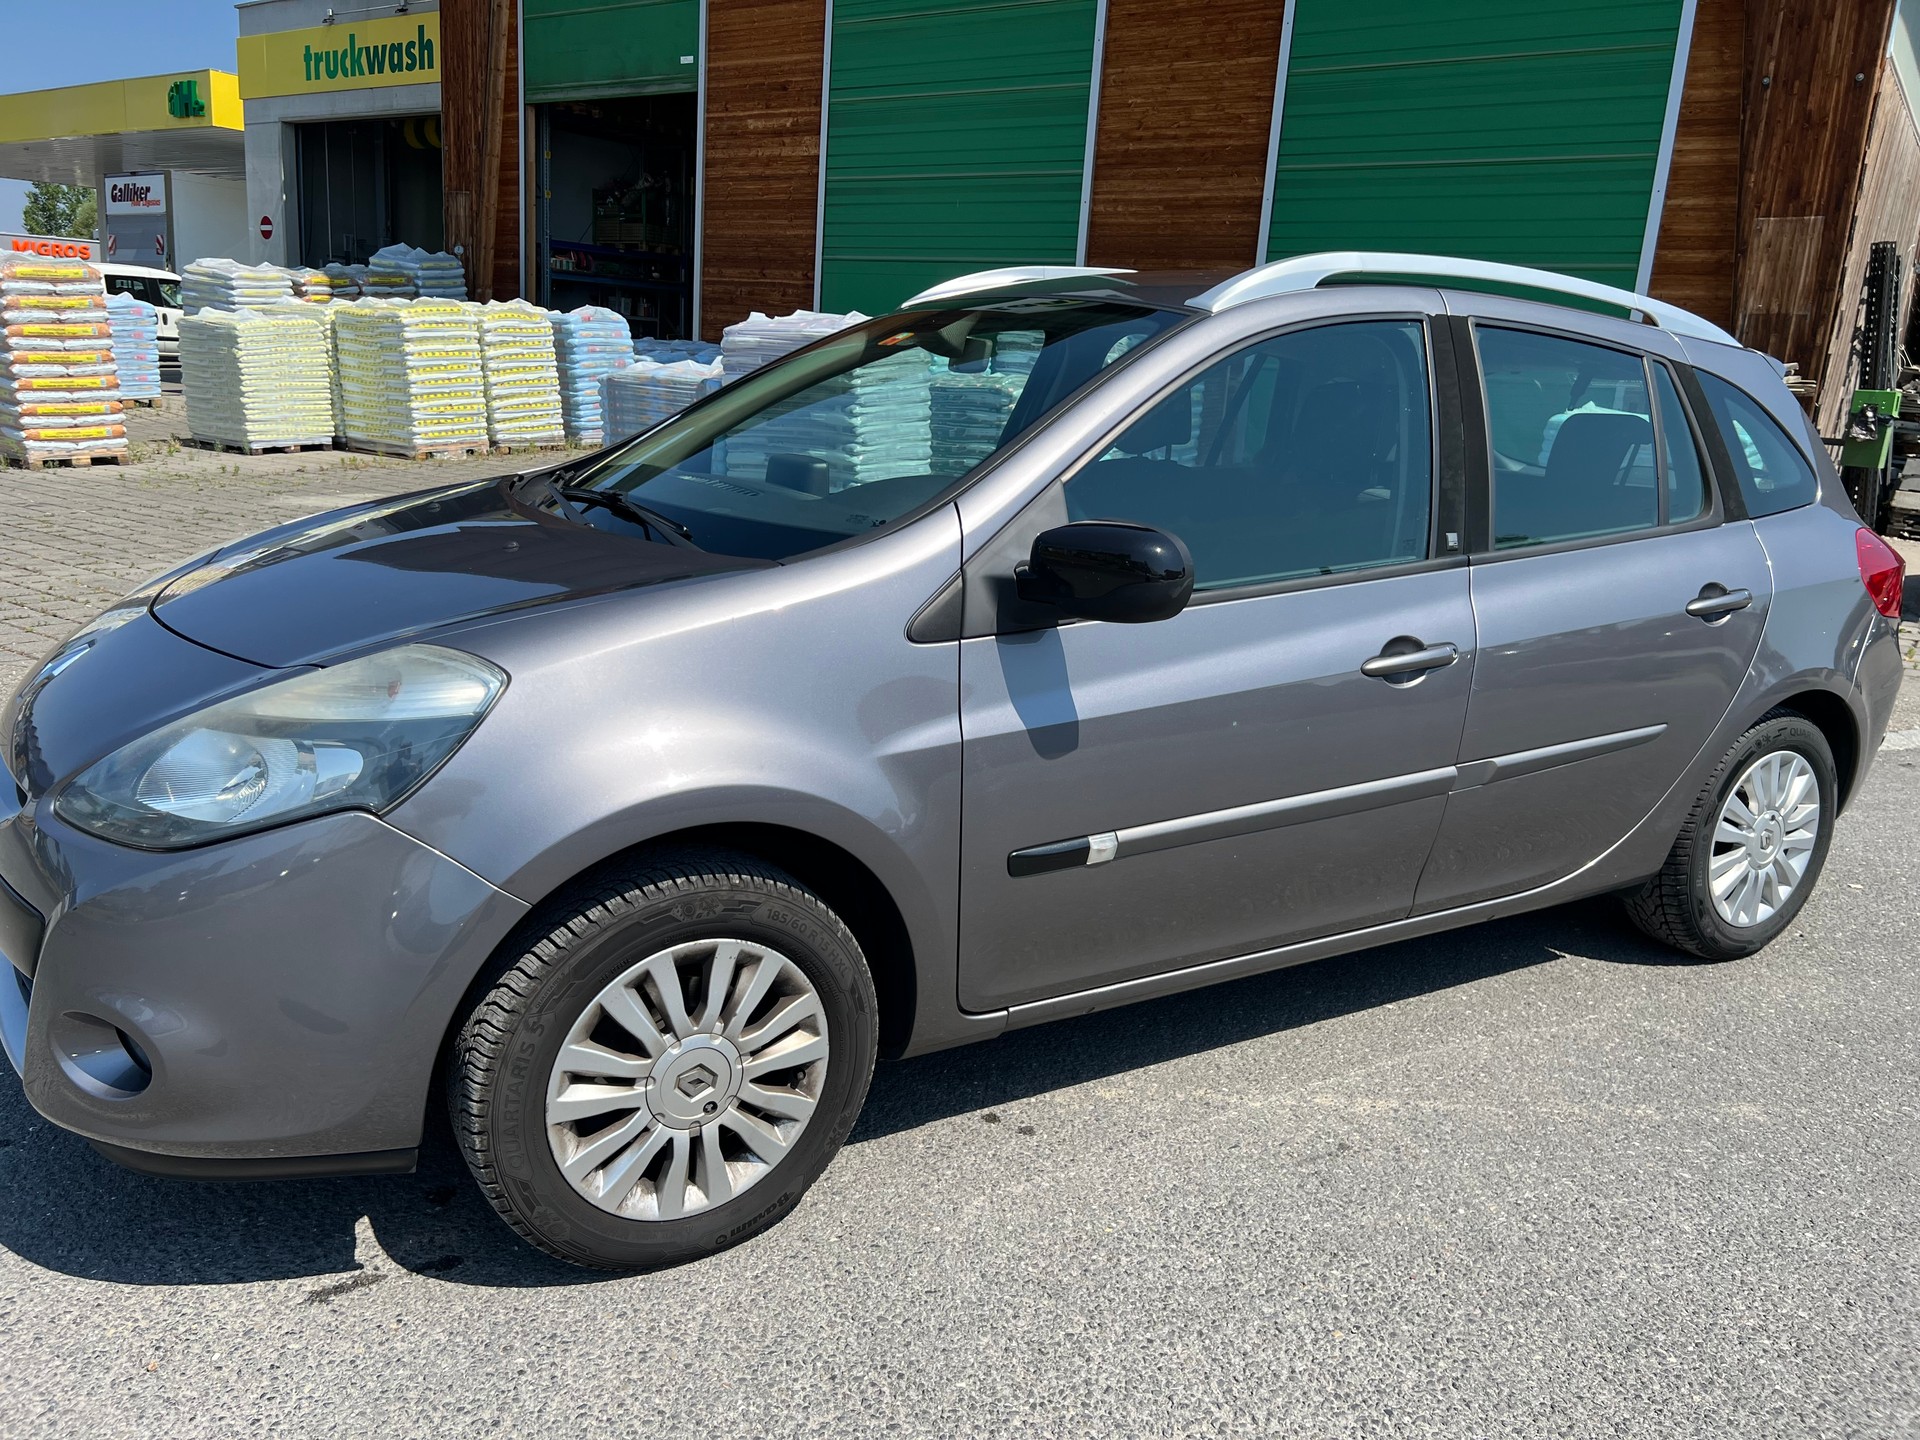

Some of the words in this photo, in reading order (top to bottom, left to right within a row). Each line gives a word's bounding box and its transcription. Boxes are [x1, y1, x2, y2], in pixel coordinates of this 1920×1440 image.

[304, 25, 434, 81] truckwash
[111, 183, 151, 203] Galliker
[12, 240, 91, 260] MIGROS
[767, 908, 808, 934] 185/60
[504, 1040, 537, 1169] QUARTARIS
[730, 1191, 796, 1237] Barum
